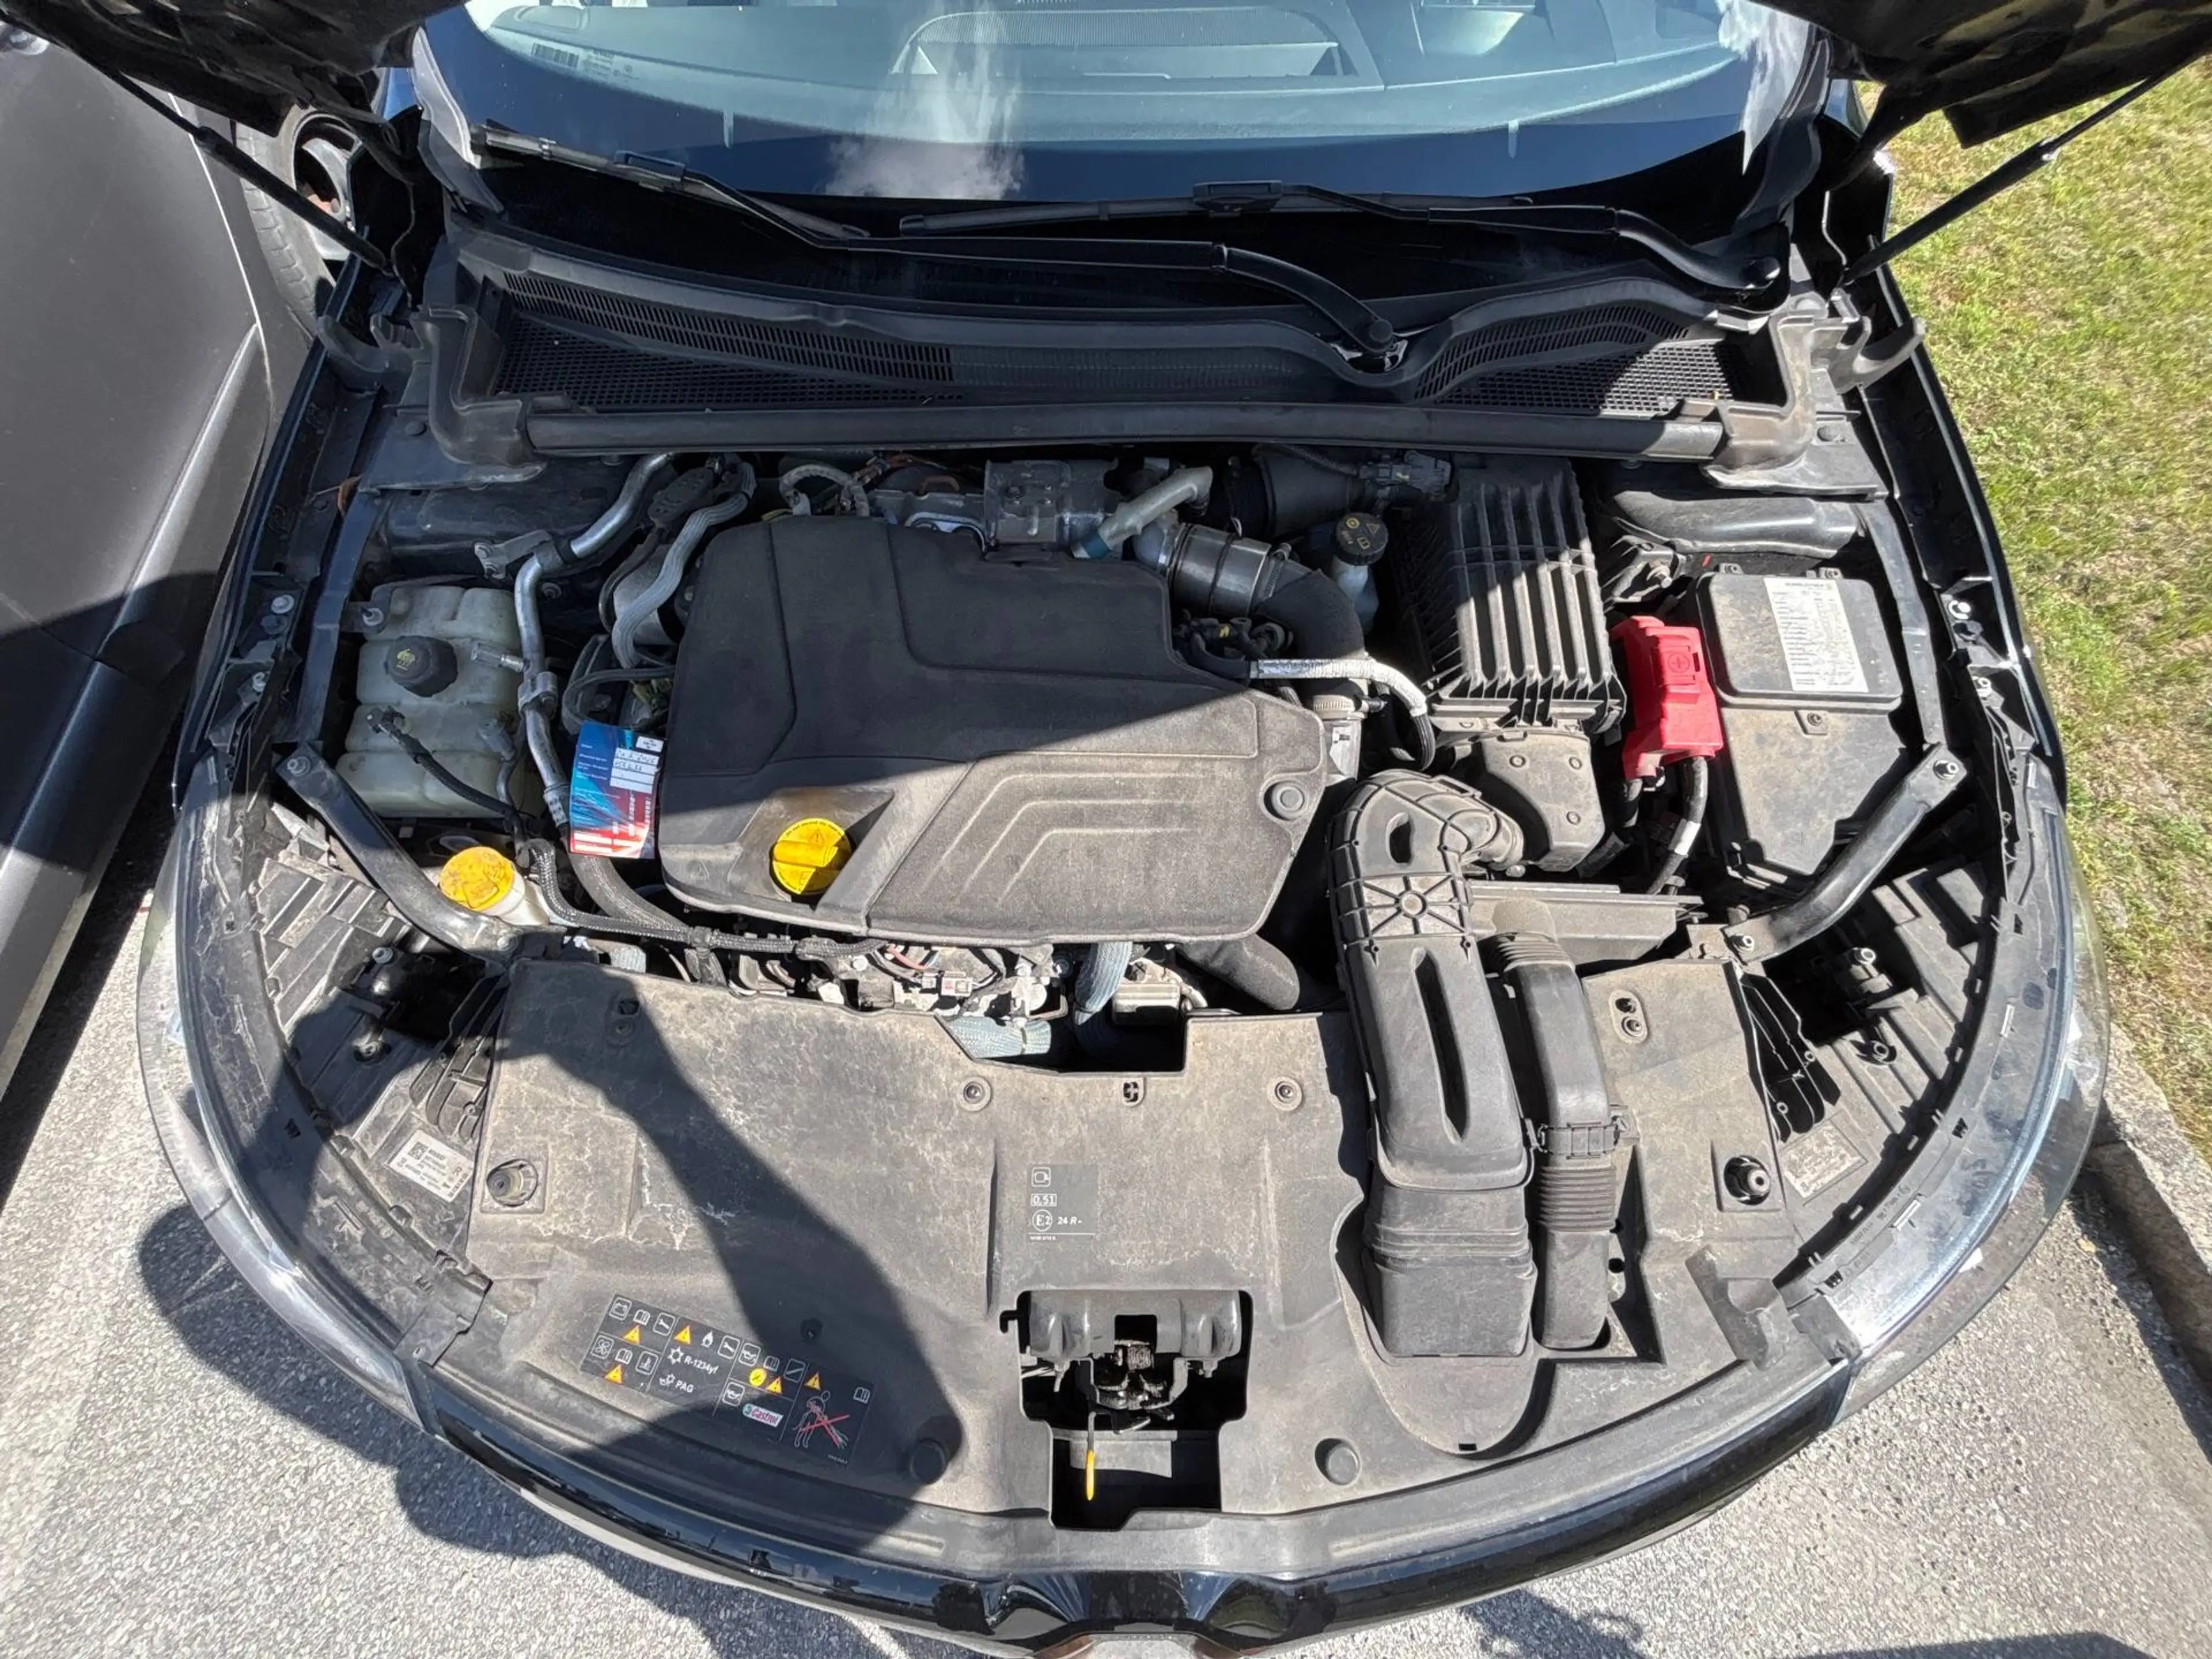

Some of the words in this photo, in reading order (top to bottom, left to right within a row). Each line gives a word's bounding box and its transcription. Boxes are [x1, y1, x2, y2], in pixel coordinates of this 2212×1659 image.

[1033, 1195, 1054, 1206] 0,51
[1036, 1214, 1051, 1226] E2
[1058, 1216, 1068, 1225] 24
[684, 1355, 719, 1374] R-1234yf
[675, 1380, 694, 1393] PAG
